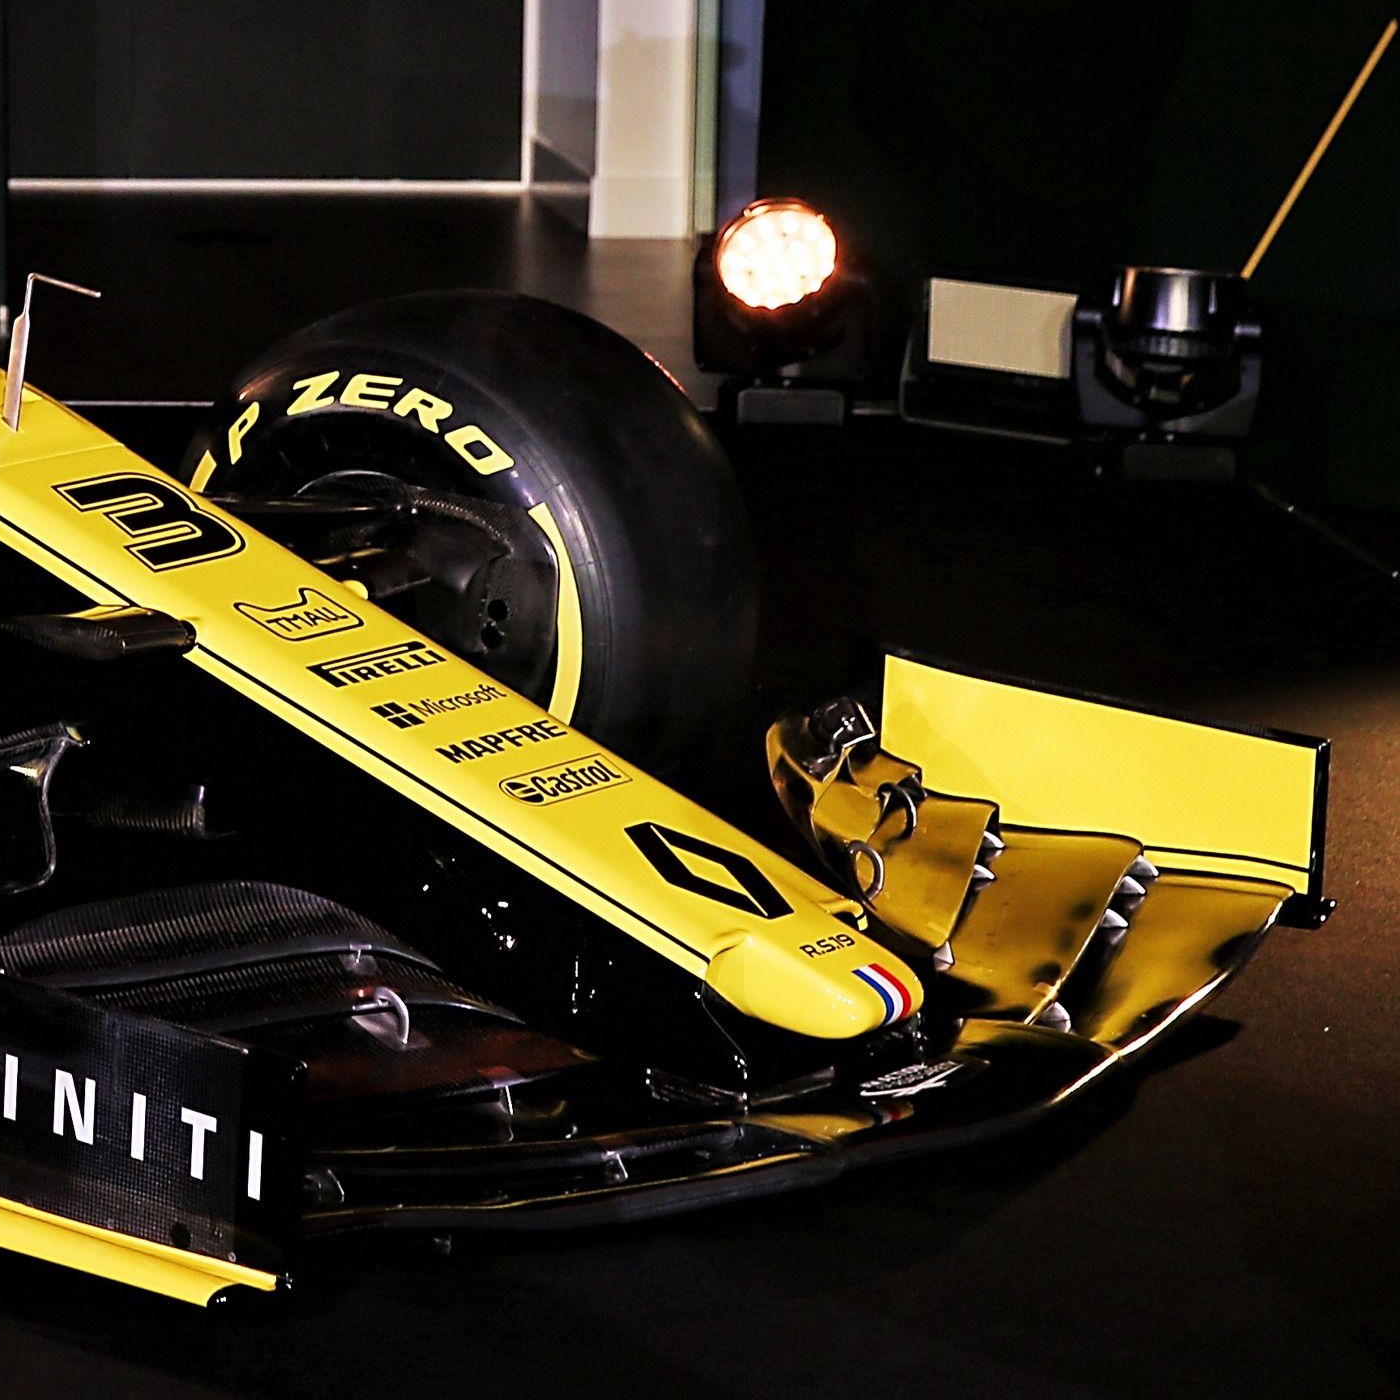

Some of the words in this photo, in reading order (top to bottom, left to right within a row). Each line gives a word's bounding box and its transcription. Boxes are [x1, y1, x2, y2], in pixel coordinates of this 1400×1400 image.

[228, 402, 260, 465] P
[287, 370, 516, 476] ZERO
[52, 470, 245, 572] 3
[265, 605, 351, 634] TMALL
[306, 641, 447, 688] PIRELLI
[411, 683, 508, 718] Microsoft
[435, 719, 569, 764] MAPFRE
[536, 759, 622, 799] Castrol
[799, 933, 856, 958] R.S.19
